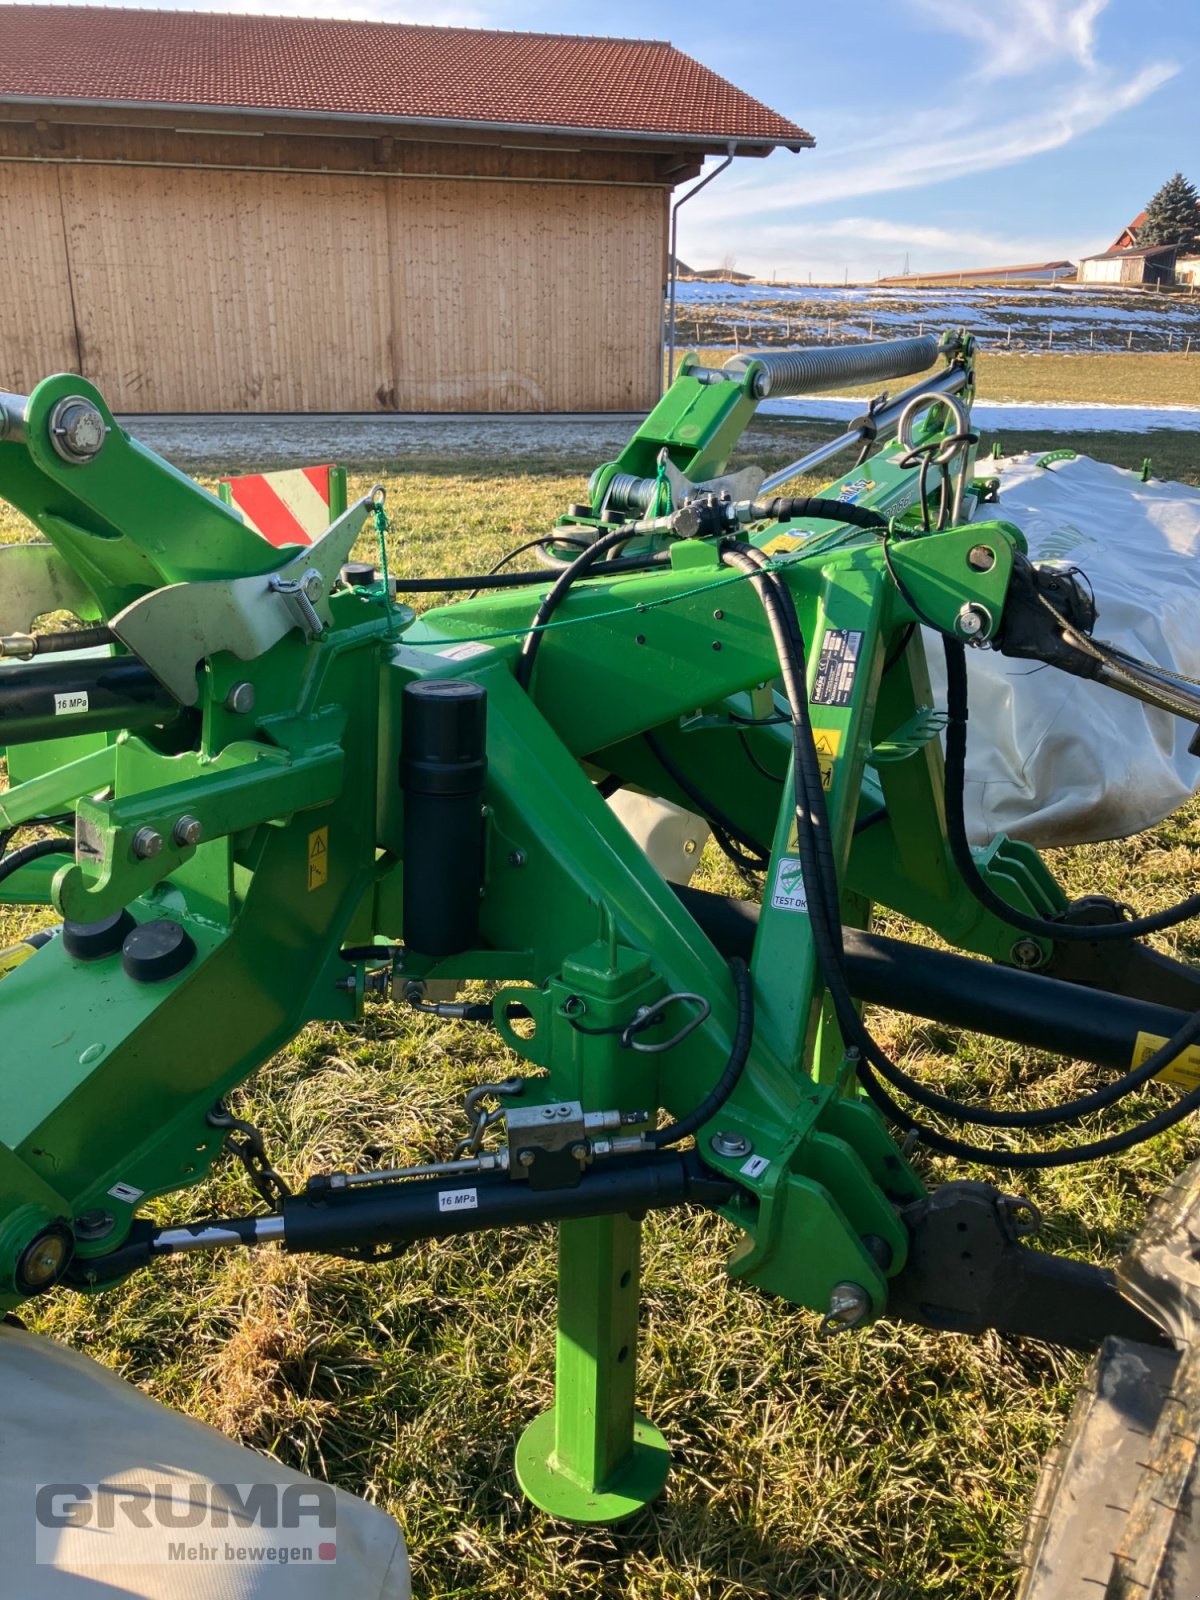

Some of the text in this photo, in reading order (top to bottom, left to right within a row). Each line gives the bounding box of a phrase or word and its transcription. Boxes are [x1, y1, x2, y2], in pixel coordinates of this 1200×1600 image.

[57, 698, 87, 709] 16 MPa
[775, 896, 807, 908] TEST OK
[441, 1194, 476, 1206] 16 MPa
